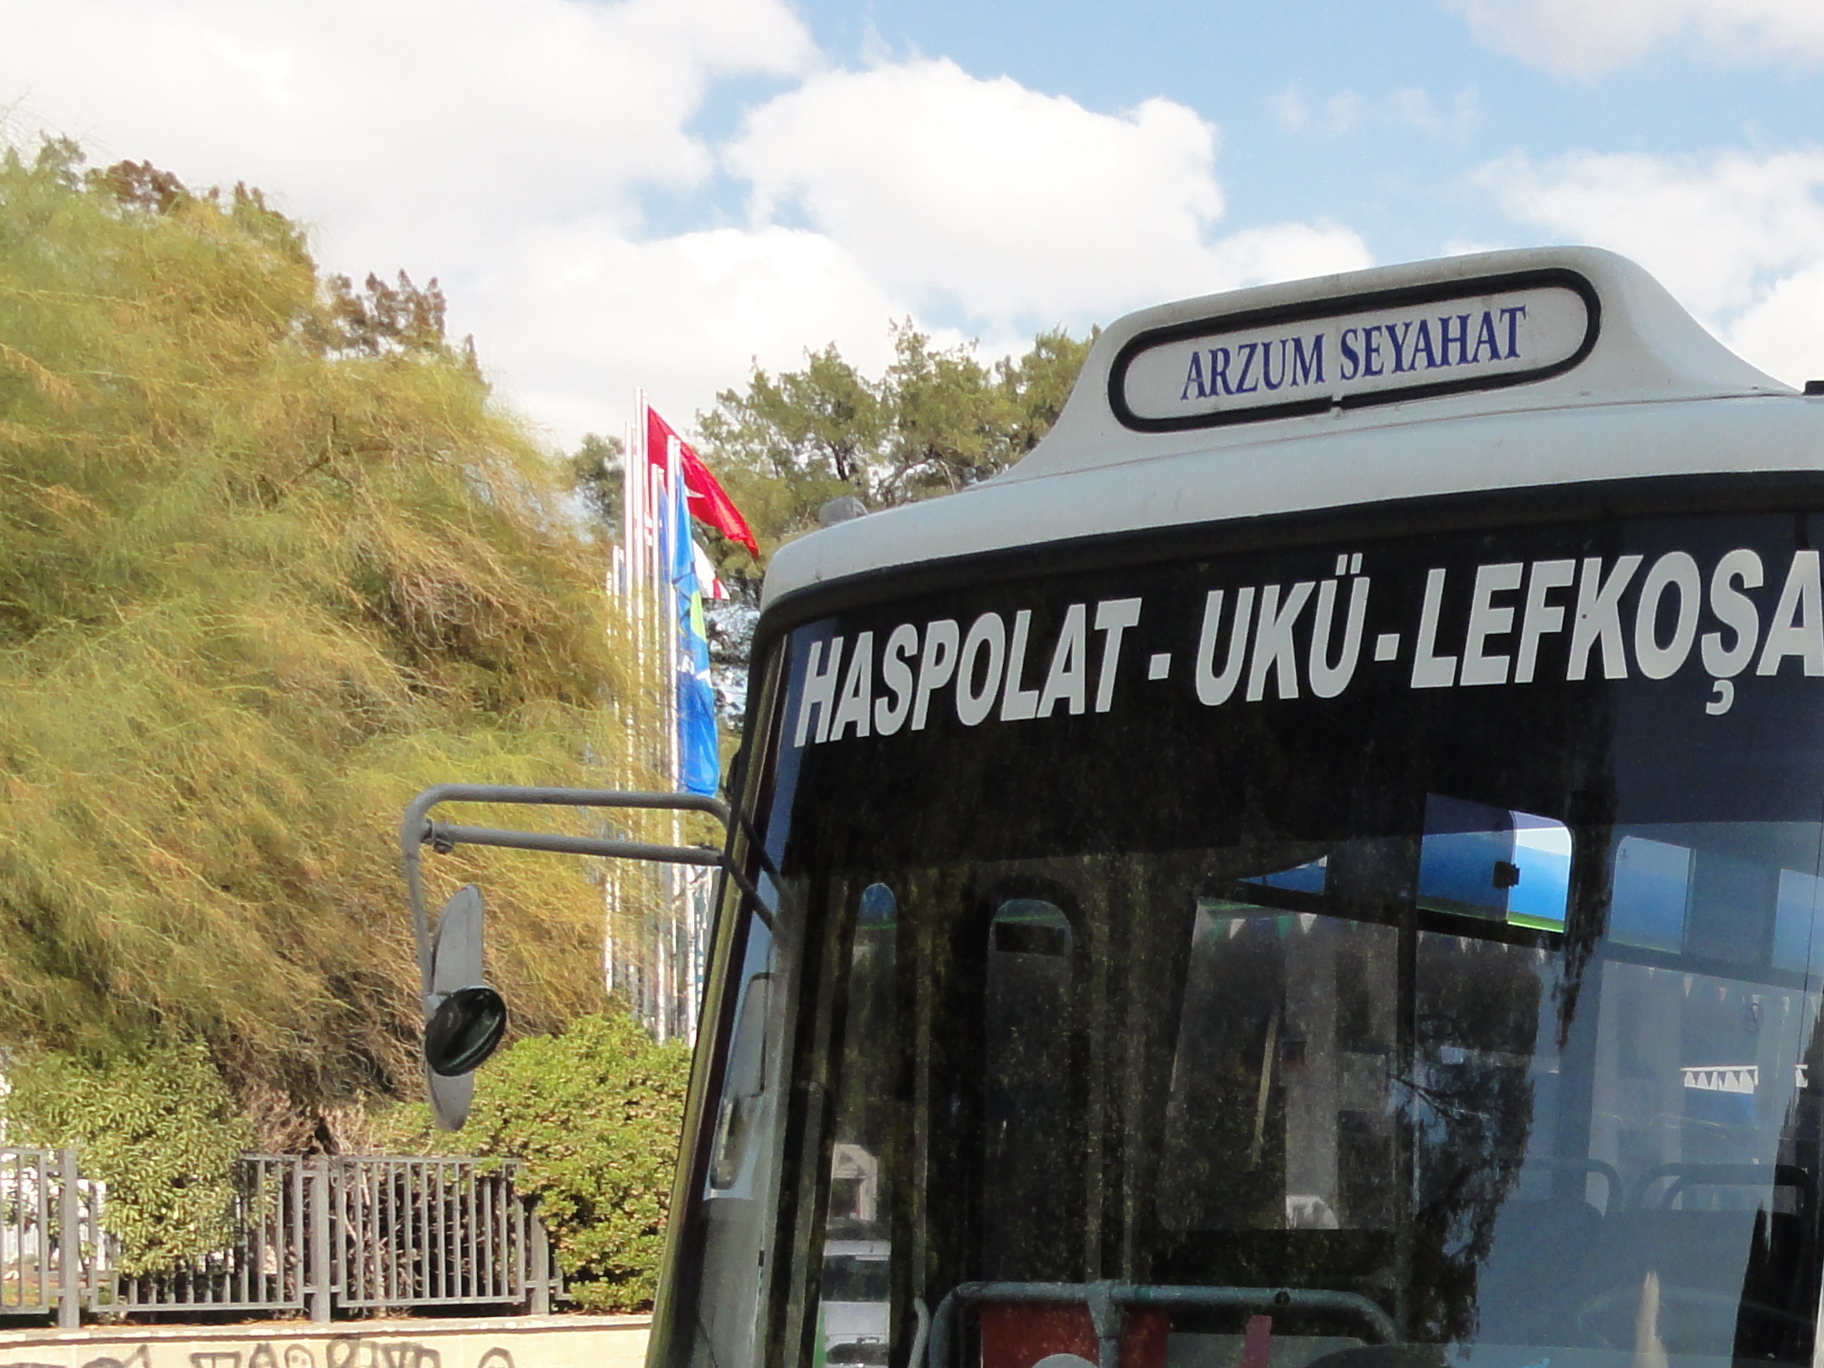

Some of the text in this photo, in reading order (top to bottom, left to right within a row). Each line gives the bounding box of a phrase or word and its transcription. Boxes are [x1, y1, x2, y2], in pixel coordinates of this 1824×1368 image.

[1181, 305, 1527, 400] ARZUM SEYAHAT
[795, 597, 1141, 746] HASPOLAT
[1196, 553, 1370, 706] UKÜ
